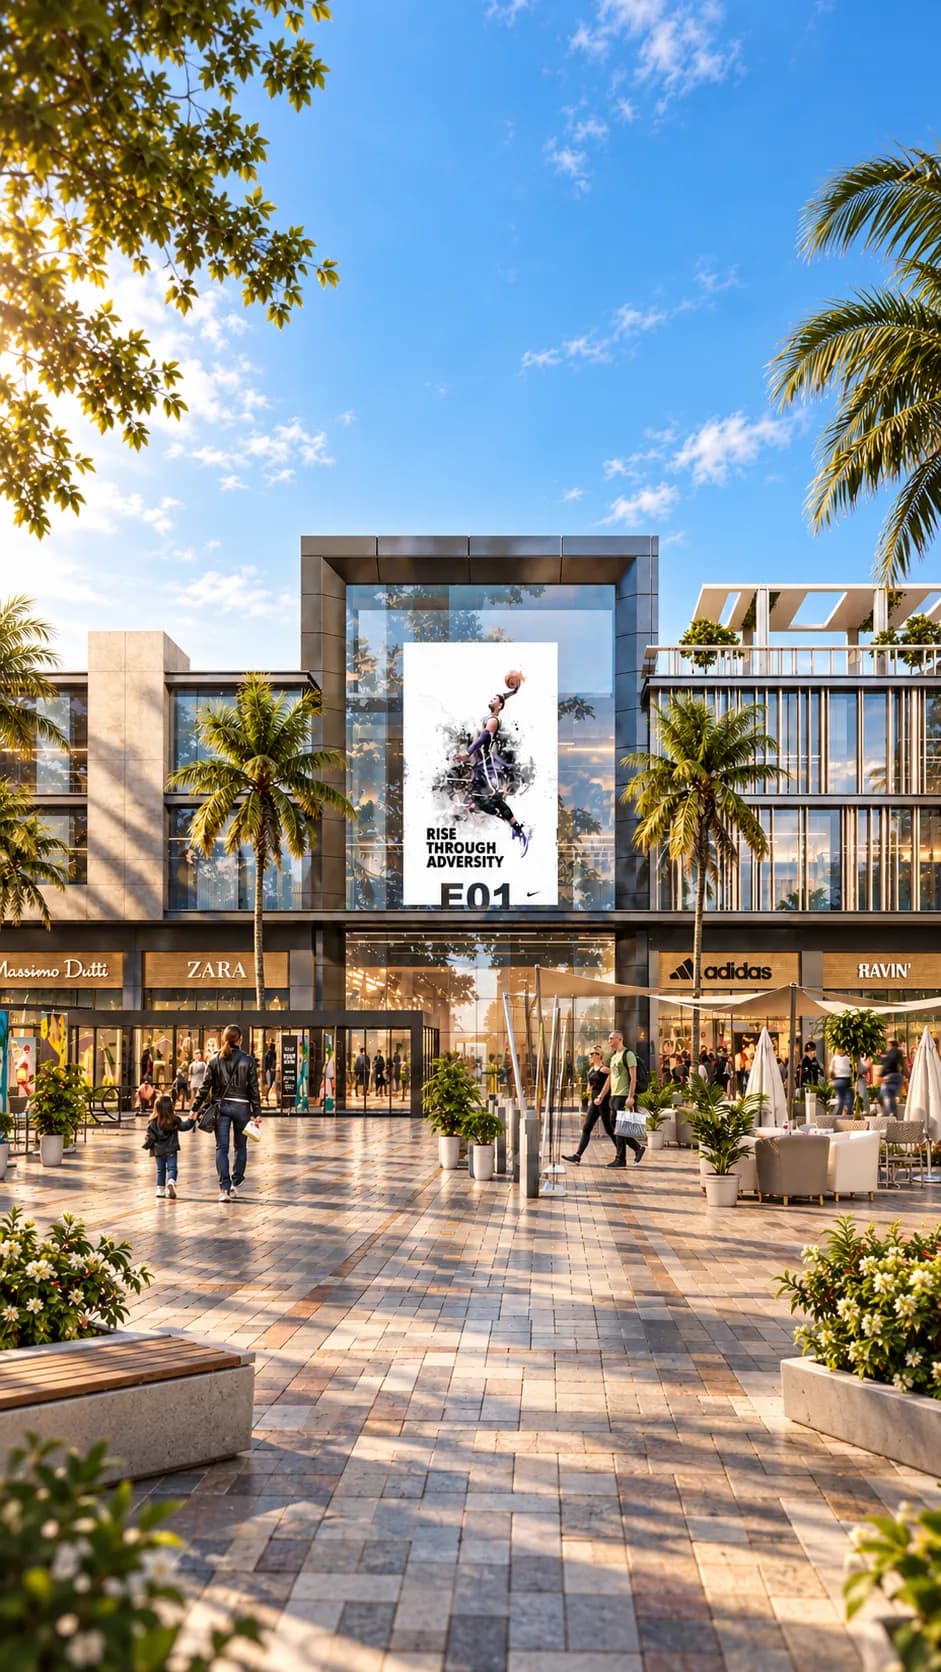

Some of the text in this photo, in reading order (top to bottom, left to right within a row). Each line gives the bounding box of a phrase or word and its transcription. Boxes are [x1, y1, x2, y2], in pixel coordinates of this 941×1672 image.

[426, 828, 457, 840] RISE
[426, 842, 496, 854] THROUGH
[426, 856, 504, 868] ADVERSITY
[441, 882, 510, 910] E01
[0, 959, 109, 978] Massimo Dutti
[187, 961, 247, 978] ZARA
[704, 962, 772, 980] adidas
